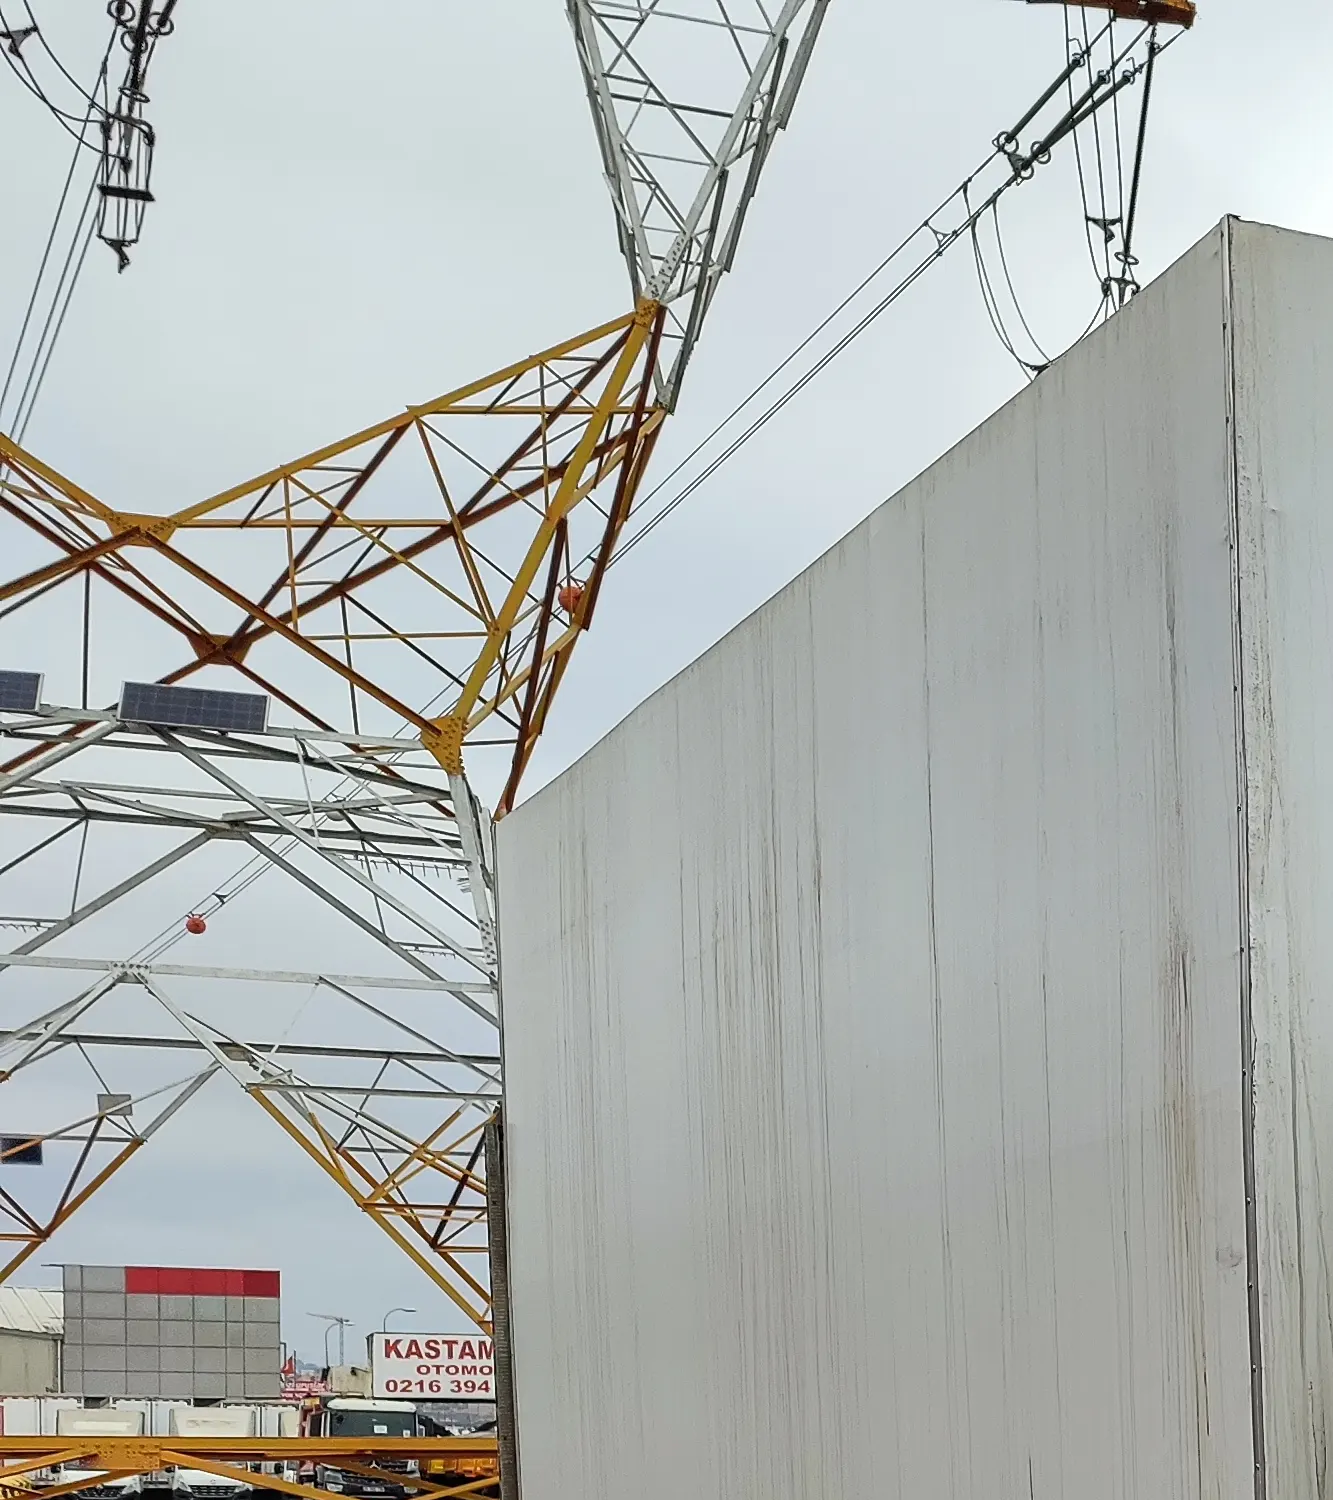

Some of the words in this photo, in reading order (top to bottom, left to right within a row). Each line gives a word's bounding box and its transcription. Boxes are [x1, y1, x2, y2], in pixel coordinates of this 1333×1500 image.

[416, 1364, 493, 1376] OTOMO
[385, 1379, 441, 1393] 0216
[450, 1379, 491, 1393] 394
